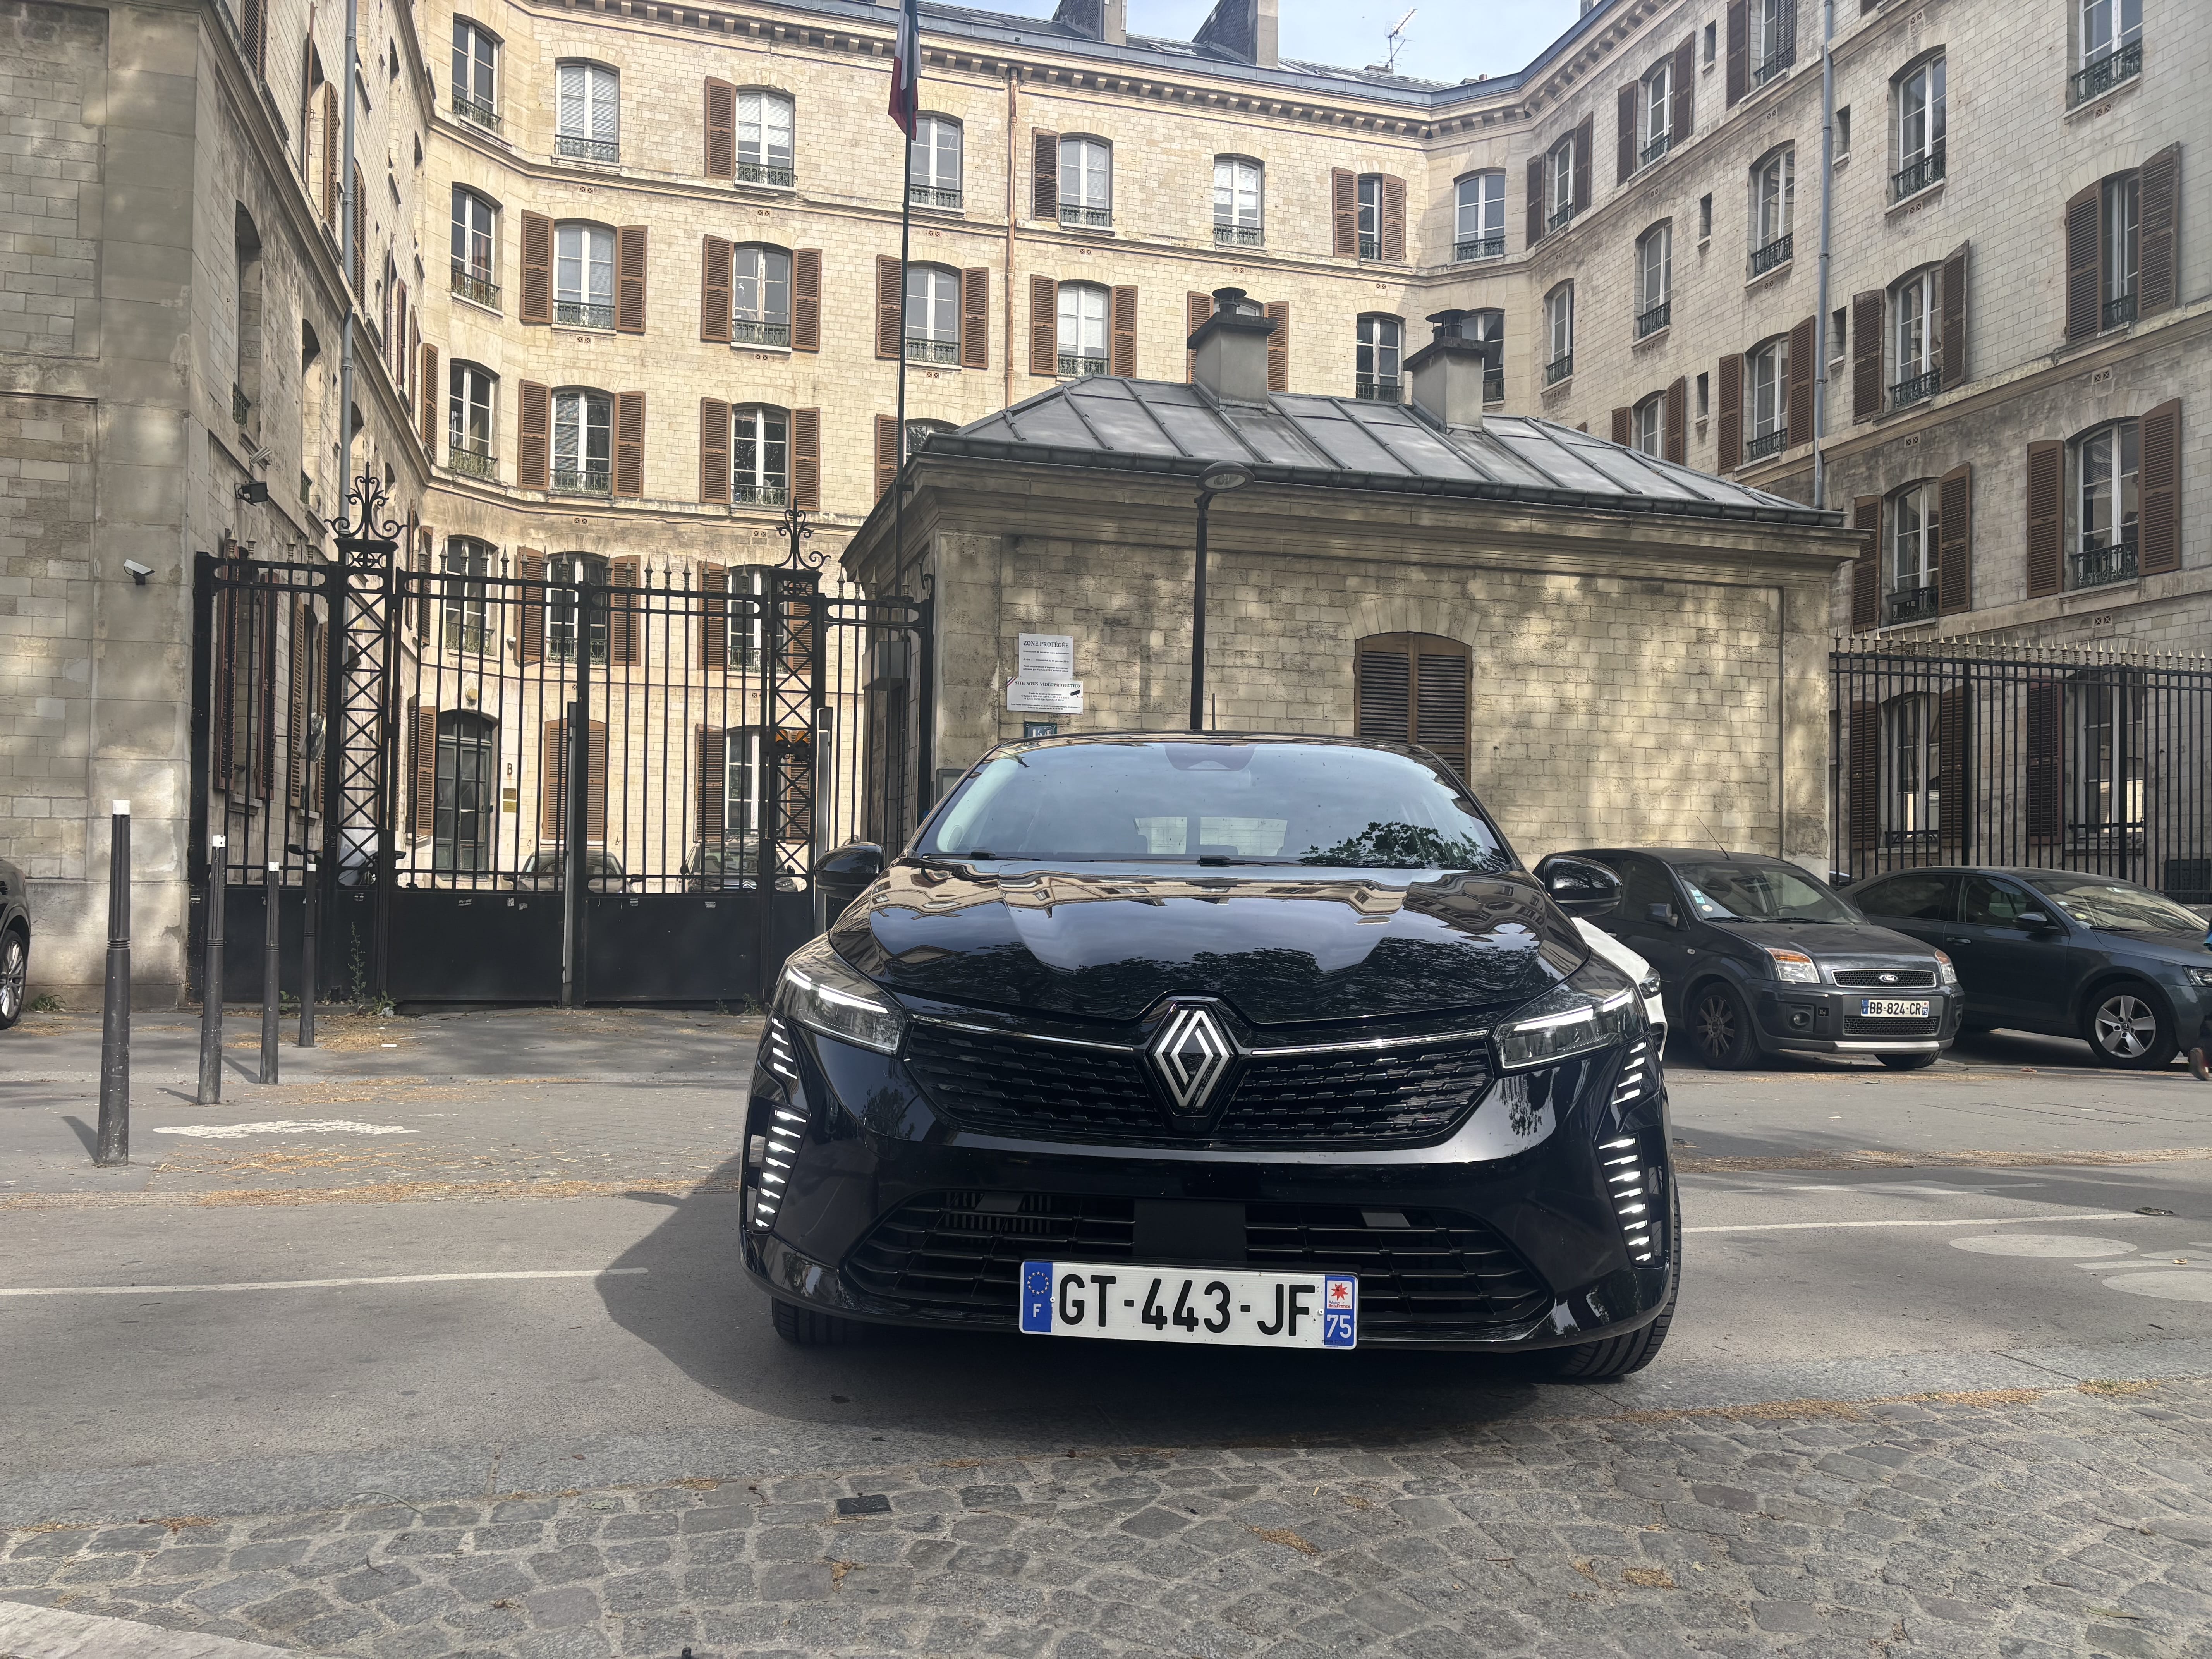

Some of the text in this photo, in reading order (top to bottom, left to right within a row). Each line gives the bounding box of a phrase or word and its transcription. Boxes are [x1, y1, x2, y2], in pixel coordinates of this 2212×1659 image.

[507, 763, 513, 775] B
[1870, 1002, 1921, 1015] BB-824-CR
[1033, 1304, 1042, 1317] F
[1059, 1274, 1316, 1336] GT-443-JF
[1327, 1314, 1352, 1338] 75
